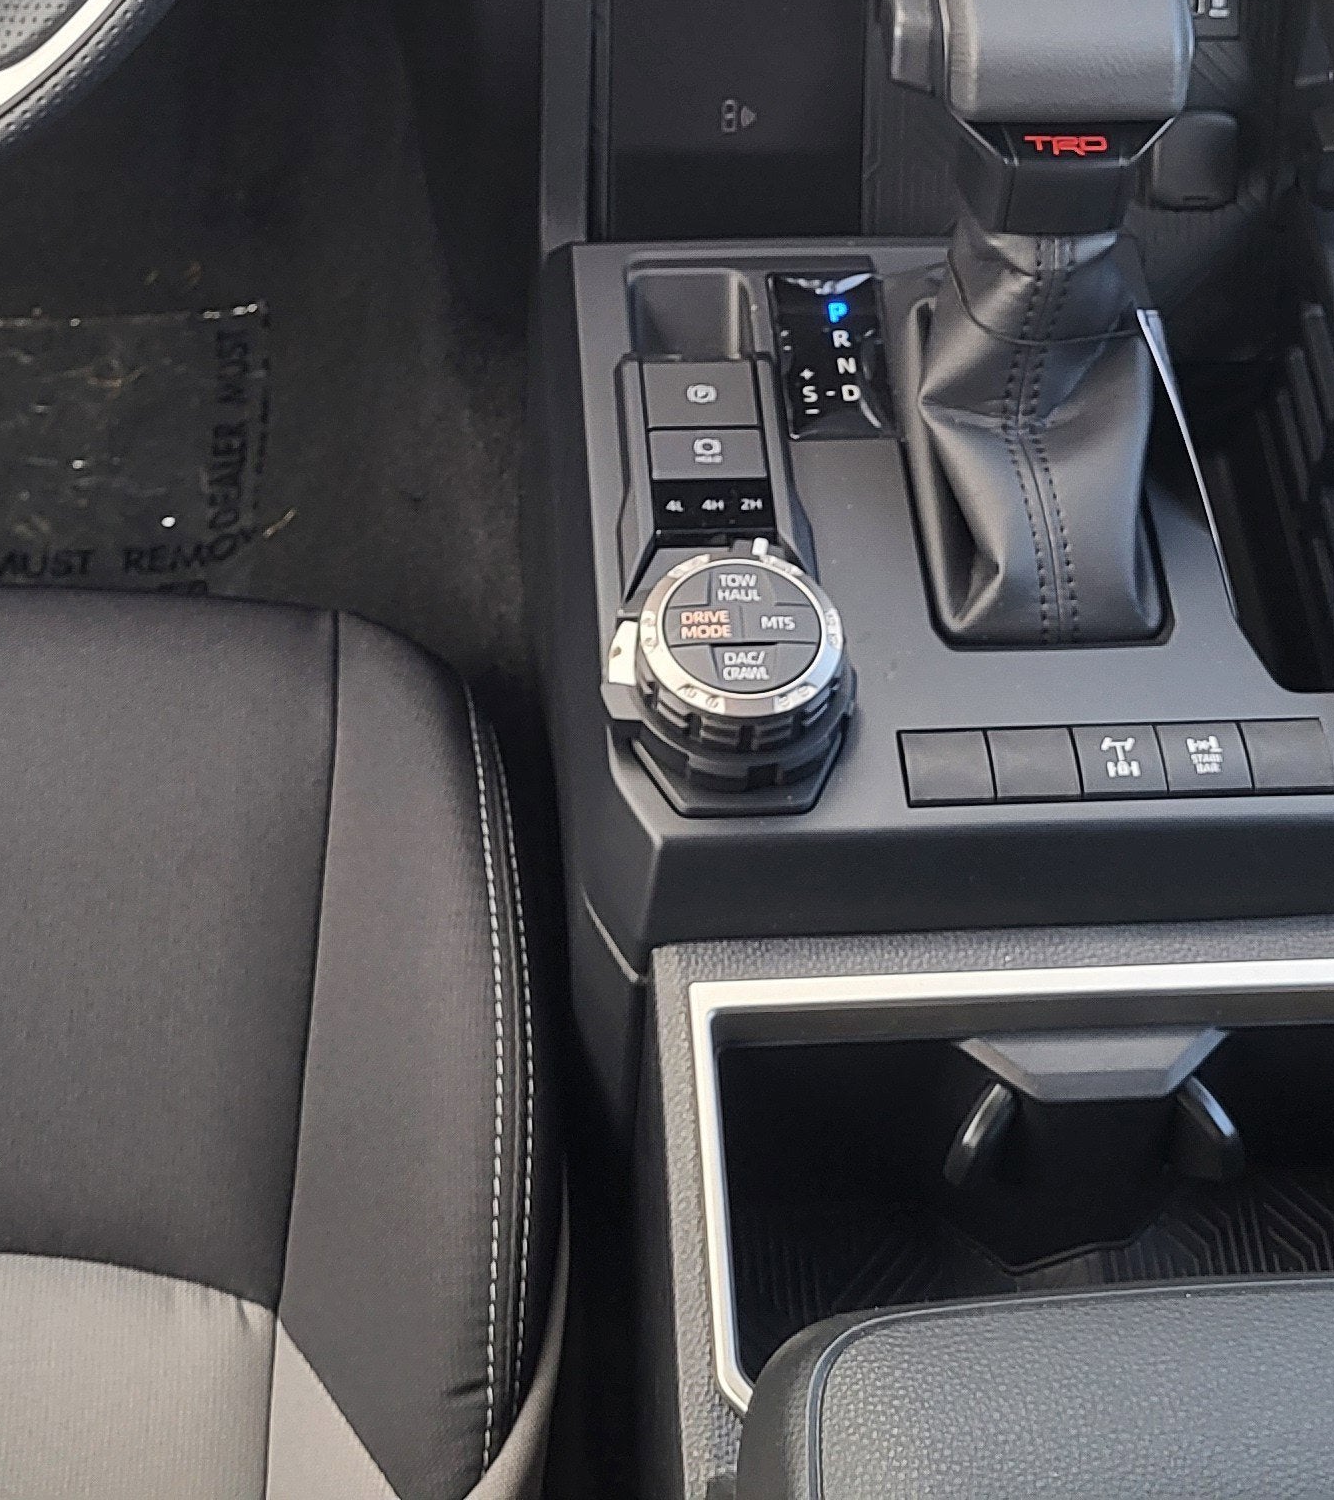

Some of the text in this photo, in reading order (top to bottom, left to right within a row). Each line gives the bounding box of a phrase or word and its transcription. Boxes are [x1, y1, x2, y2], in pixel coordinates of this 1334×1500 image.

[1023, 135, 1108, 156] TRD
[827, 301, 849, 324] P
[832, 329, 852, 349] R
[836, 357, 858, 376] N
[801, 384, 862, 404] S D
[664, 499, 685, 513] 4L
[701, 498, 726, 512] 4H
[739, 497, 764, 512] 2H
[718, 572, 759, 588] TOW
[717, 588, 763, 603] HAUL
[679, 609, 732, 626] DRIVE
[759, 615, 797, 632] MTS
[679, 624, 733, 640] MODE
[722, 650, 766, 666] DAC/
[722, 666, 771, 682] CRAWL
